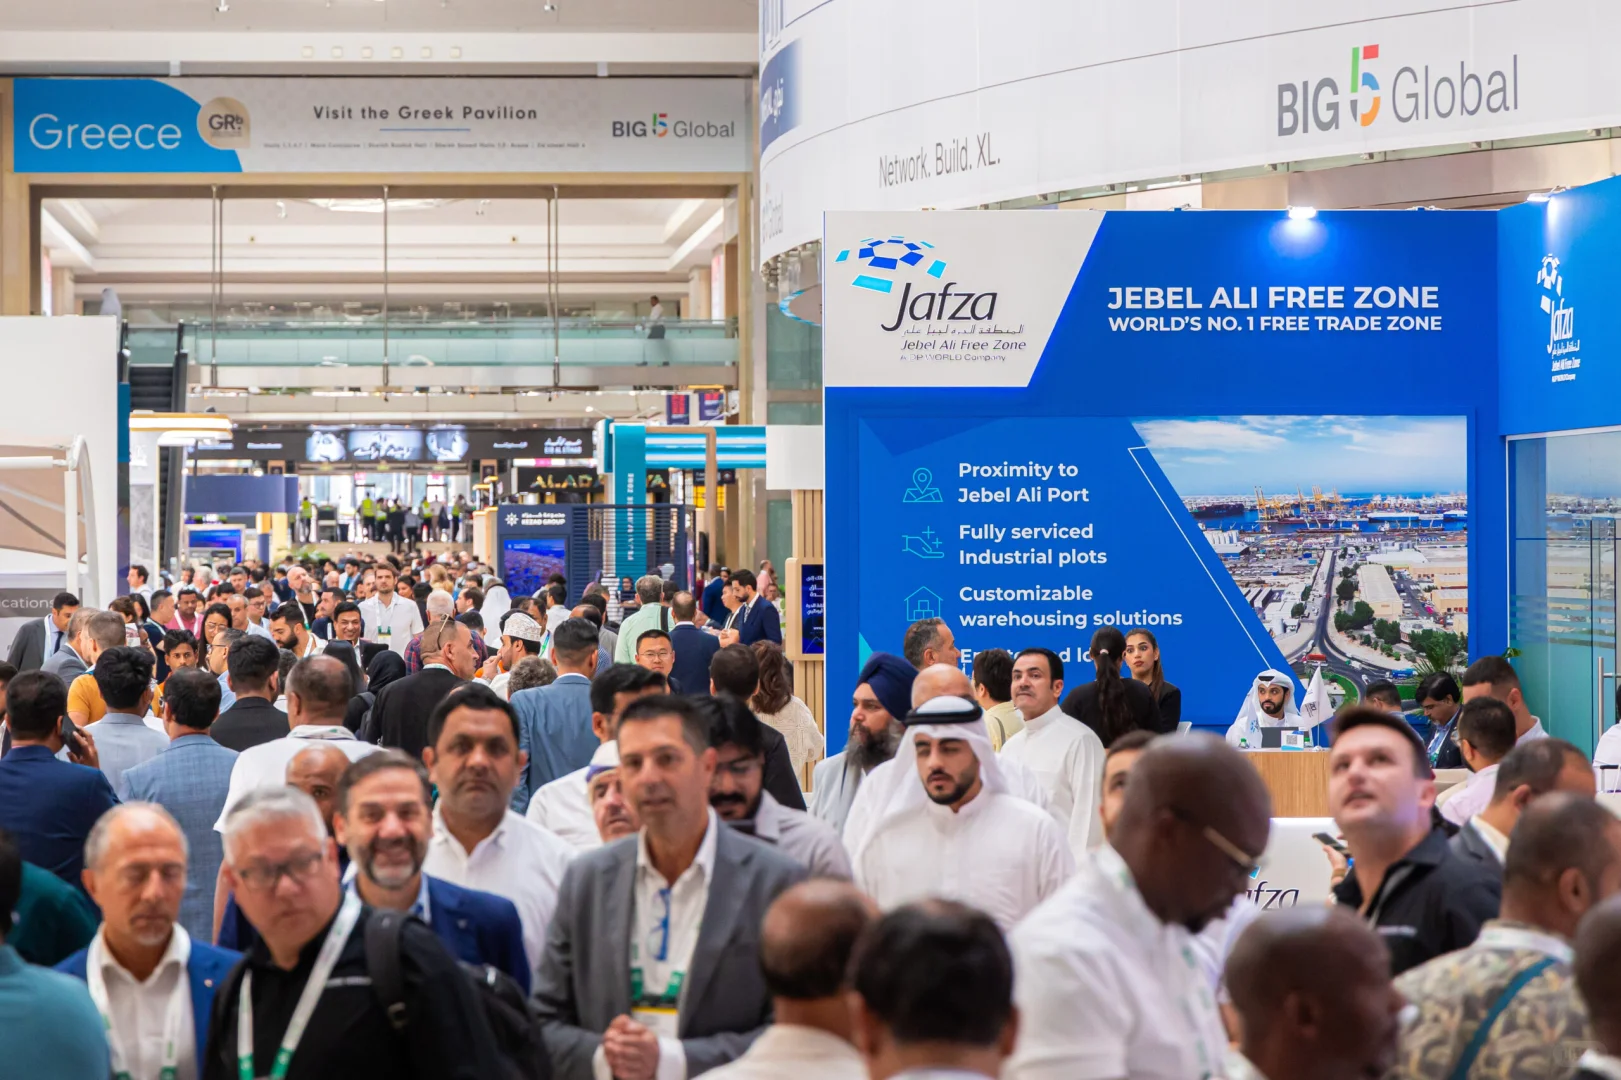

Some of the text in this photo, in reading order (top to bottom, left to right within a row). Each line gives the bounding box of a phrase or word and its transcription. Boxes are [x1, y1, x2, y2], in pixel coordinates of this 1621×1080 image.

[1278, 43, 1519, 137] BIG 5 Global
[314, 106, 537, 119] Visit the Greek Pavilion
[29, 113, 182, 150] Greece
[612, 113, 735, 137] BIG 5 Global
[879, 132, 1001, 187] Network. Build. XL.
[881, 282, 998, 332] Jafza
[1108, 286, 1439, 310] JEBEL ALI FREE ZONE
[1108, 316, 1442, 332] WORLD'S NO. 1 FREE TRADE ZONE
[1547, 298, 1574, 354] Jafza
[901, 339, 1027, 351] Jebel Ali Free Zone
[963, 354, 1006, 362] Company
[959, 461, 1079, 481] Proximity to
[958, 486, 1090, 503] Jebel Ali Port
[959, 522, 1094, 543] Fully serviced
[959, 548, 1108, 568] Industrial plots
[0, 596, 54, 608] cations
[959, 584, 1093, 602] Customizable
[959, 609, 1183, 630] warehousing solutions
[1246, 880, 1299, 910] fza
